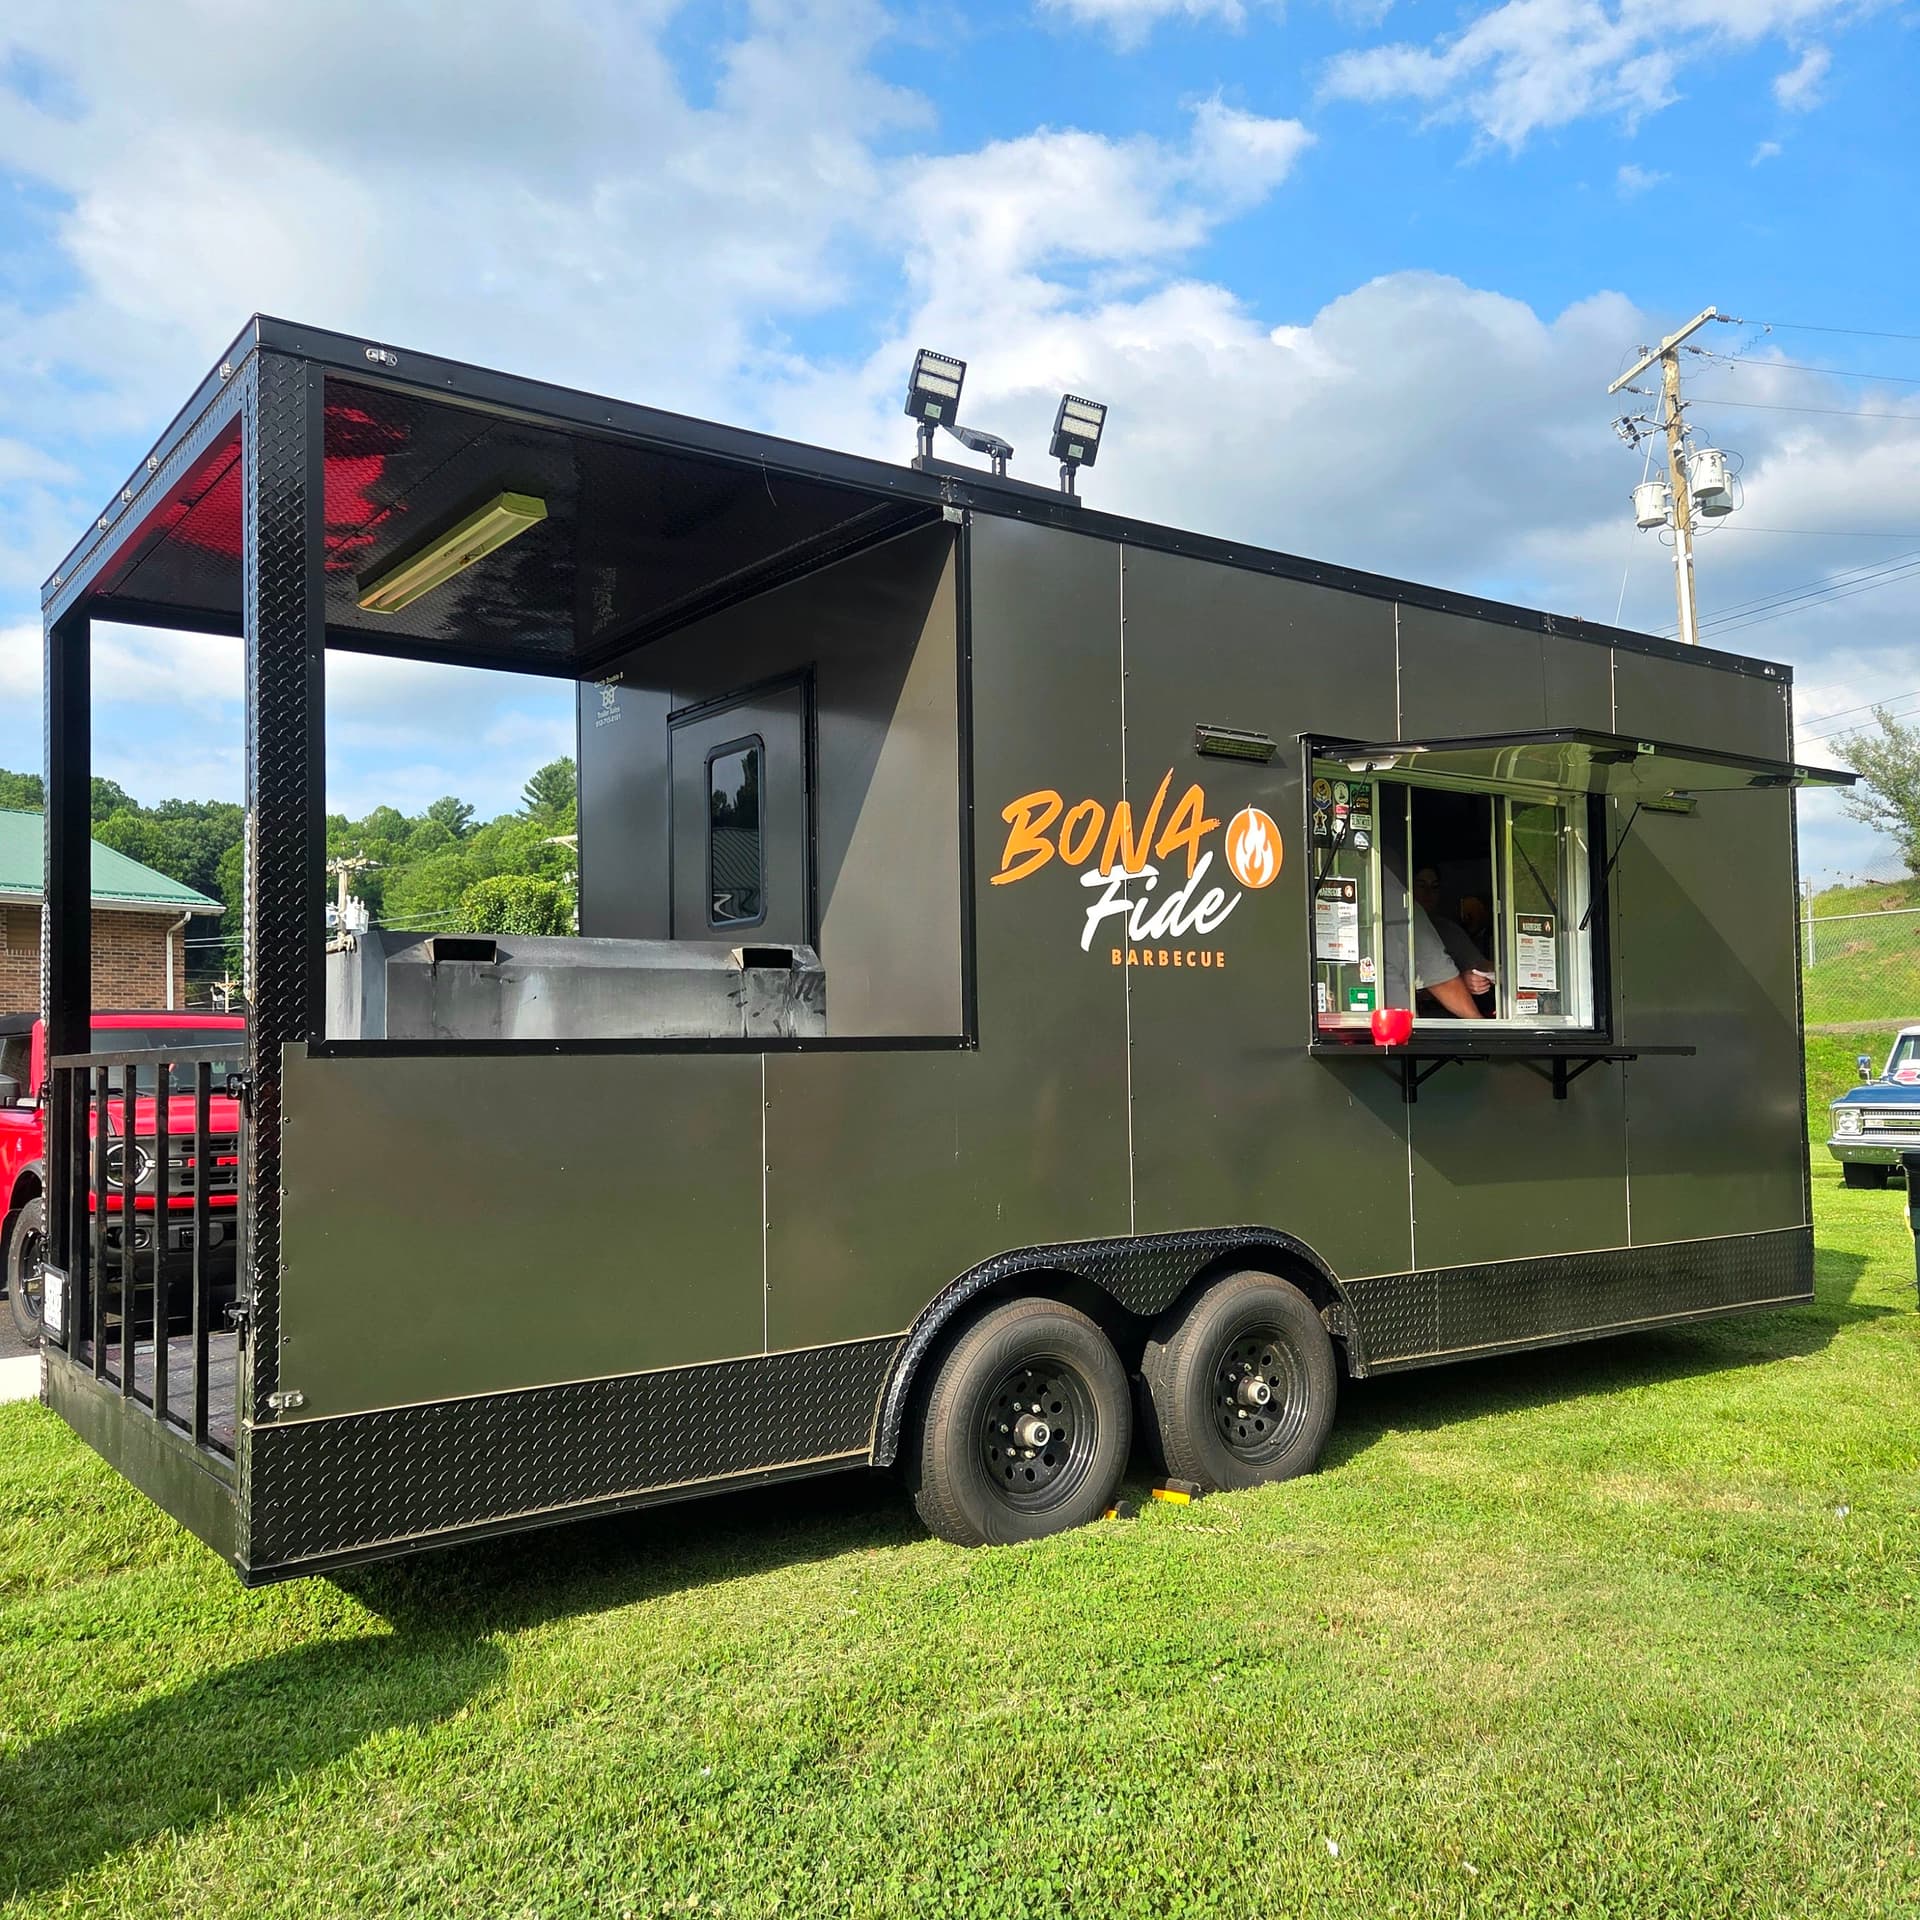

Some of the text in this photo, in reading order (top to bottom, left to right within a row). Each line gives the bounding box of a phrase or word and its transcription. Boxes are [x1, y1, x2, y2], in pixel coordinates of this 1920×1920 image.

[990, 768, 1221, 885] BONA
[1080, 851, 1242, 952] Fide
[1111, 949, 1225, 968] BARBECUE
